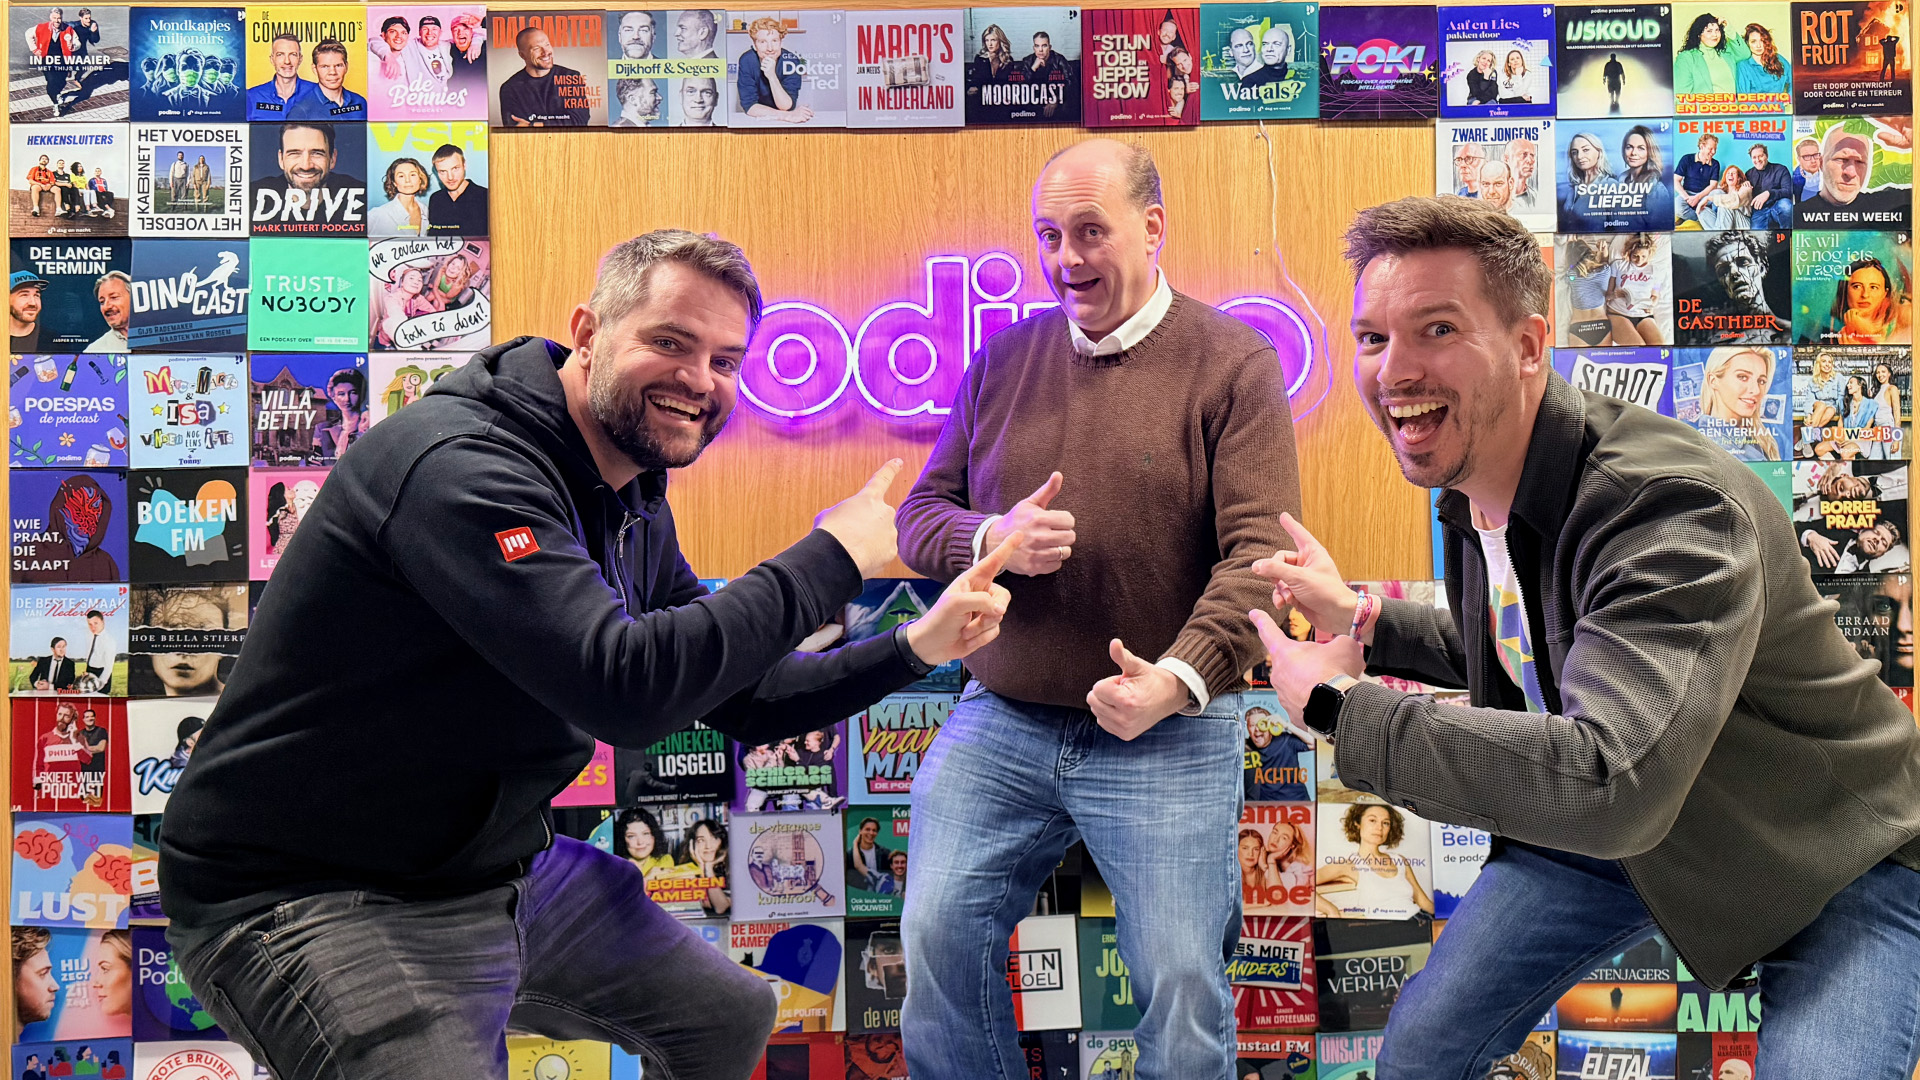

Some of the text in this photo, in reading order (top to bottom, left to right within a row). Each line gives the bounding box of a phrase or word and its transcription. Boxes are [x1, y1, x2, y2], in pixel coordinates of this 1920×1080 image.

[150, 19, 230, 32] Mondkapjes
[1446, 18, 1520, 31] Aaf en Lies
[1566, 20, 1660, 42] IJSKOUD
[1800, 10, 1853, 44] ROT
[158, 33, 224, 46] miljonairs
[1101, 34, 1150, 51] STIJN
[1446, 31, 1500, 40] pakken door
[857, 24, 953, 65] NARCO'S
[29, 55, 111, 65] IN DE WAAIER
[1093, 51, 1136, 67] TOBI
[1802, 44, 1850, 65] FRUIT
[616, 62, 719, 77] Dijkhoff & Segers
[783, 59, 842, 76] Dokter
[410, 73, 434, 90] de
[554, 75, 587, 85] MISSIE
[810, 75, 839, 90] Ted
[1093, 67, 1149, 84] JEPPE
[558, 86, 600, 97] MENTALE
[1093, 83, 1150, 99] SHOW
[1220, 80, 1302, 100] Wat als?
[1850, 81, 1892, 89] ONTWRICHT
[389, 85, 468, 108] Bennies
[859, 85, 954, 110] IN NEDERLAND
[982, 84, 1065, 106] MOORDCAST
[1676, 92, 1790, 102] TUSSEN DERTIG
[1825, 89, 1856, 97] COCAÏNE
[1869, 89, 1902, 97] TERREUR
[333, 105, 360, 114] VICTOR
[564, 98, 601, 109] KRACHT
[1676, 104, 1783, 113] EN DOODGAAN.
[1011, 110, 1036, 118] podimo
[1678, 120, 1787, 133] DE HETE BRIJ
[27, 134, 114, 146] HEKKENSLUITERS
[138, 129, 243, 142] HET VOEDSEL
[1452, 128, 1538, 143] ZWARE JONGENS
[137, 145, 150, 214] KABINET
[230, 146, 242, 214] KABINET
[1577, 182, 1654, 195] SCHADUW
[252, 187, 365, 222] DRIVE
[1588, 194, 1643, 209] LIEFDE
[1802, 211, 1903, 222] WAT EEN WEEK!
[253, 224, 365, 232] MARK TUITERT PODCAST
[1796, 234, 1839, 247] Ik wil
[30, 247, 112, 260] DE LANGE
[1795, 248, 1873, 265] je nog iets
[35, 261, 107, 275] TERMIJN
[1796, 264, 1852, 279] vragen
[131, 265, 249, 315] DINOCAST
[265, 275, 335, 293] TRUST
[262, 296, 356, 313] NOBODY
[1679, 298, 1702, 313] DE
[137, 323, 193, 334] GIJS RADEMAKER
[1677, 314, 1784, 331] GASTHEER
[159, 329, 232, 343] MAARTEN VAN ROSSEM
[739, 252, 1315, 417] odio
[1578, 363, 1663, 406] SCHOT
[25, 397, 115, 412] POESPAS
[261, 390, 313, 410] VILLA
[39, 411, 100, 427] de podcast
[257, 410, 317, 430] BETTY
[1707, 418, 1753, 427] HELD IN
[137, 499, 237, 524] BOEKEN
[1820, 500, 1882, 516] BORREL
[13, 519, 41, 530] WIE
[1826, 513, 1876, 530] PRAAT
[13, 532, 64, 544] PRAAT,
[171, 528, 205, 552] FM
[13, 545, 36, 557] DIE
[13, 560, 71, 571] SLAAPT
[16, 598, 126, 609] DE BESTE SMAAK
[869, 702, 949, 730] MAN
[658, 752, 726, 777] LOSGELD
[39, 771, 106, 783] SKIETE WILLY
[1254, 767, 1308, 784] ACHTIG
[41, 783, 104, 799] PODCAST
[748, 822, 769, 835] de
[1325, 856, 1346, 865] OLD
[1374, 858, 1425, 866] NETWORK
[646, 877, 726, 891] BOEKEN
[17, 891, 126, 921] LUST
[731, 922, 791, 935] DE BINNEN
[139, 948, 167, 966] De
[1260, 945, 1299, 960] MOET
[61, 959, 90, 972] HIJ
[1225, 960, 1289, 981] ANDERS
[1345, 955, 1405, 975] GOED
[61, 972, 91, 981] ZEGT
[1255, 1016, 1272, 1025] VAN
[1320, 1036, 1366, 1065] ONSJE
